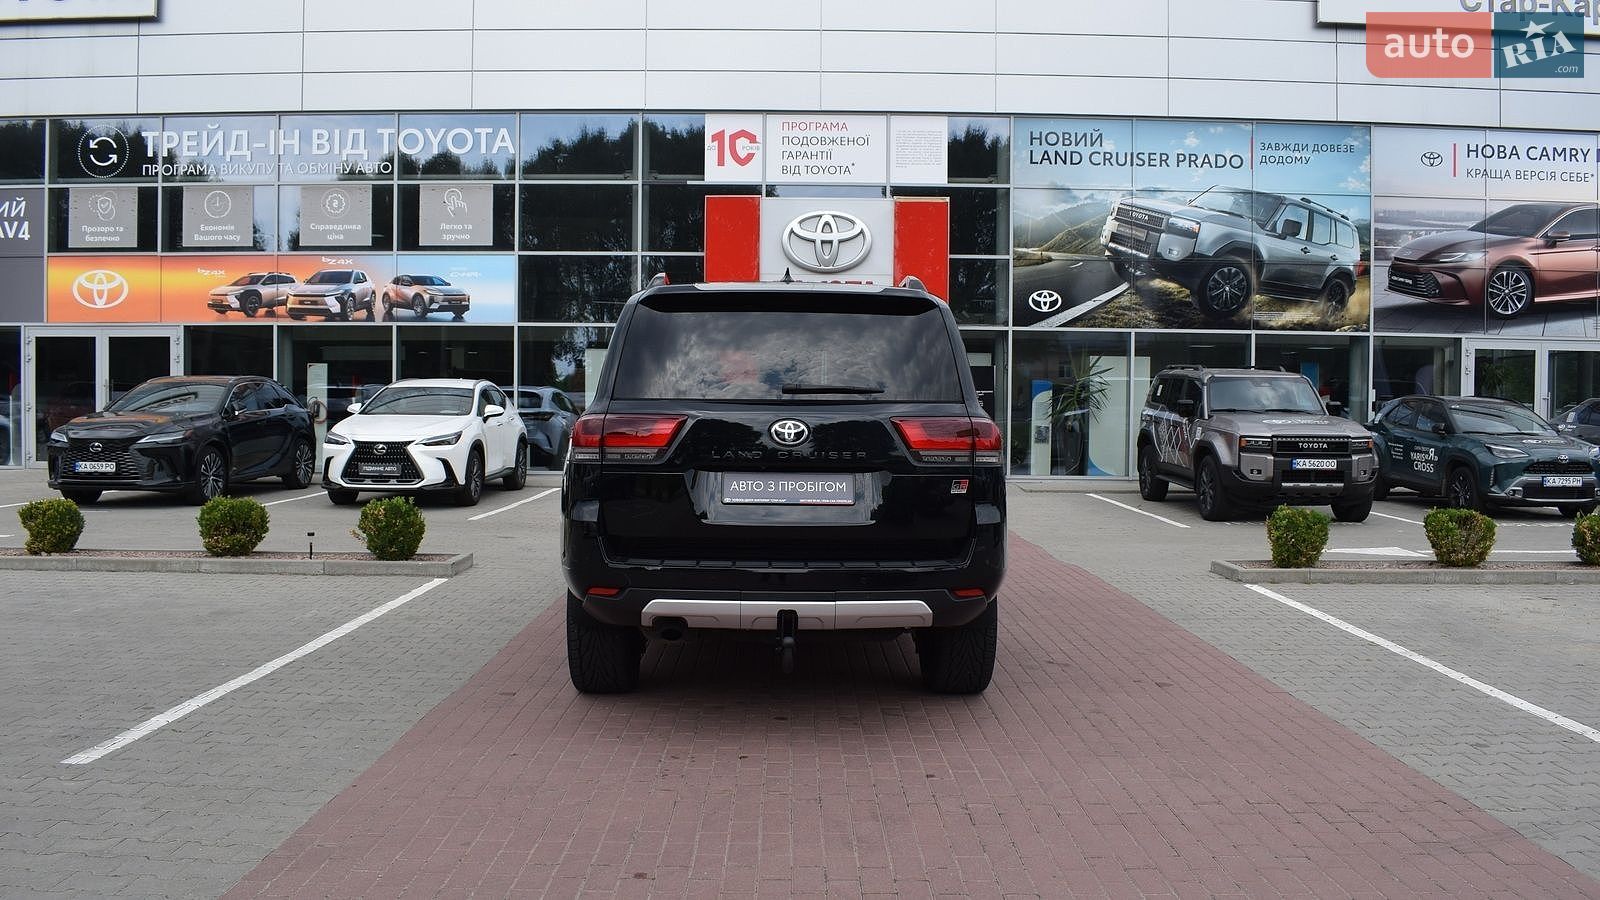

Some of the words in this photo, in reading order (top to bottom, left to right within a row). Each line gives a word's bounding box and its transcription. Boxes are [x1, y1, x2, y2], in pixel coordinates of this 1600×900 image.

[781, 121, 849, 132] ПРОГРАМА
[141, 124, 300, 161] ТРЕЙД-ІН
[312, 128, 368, 160] ВІД
[376, 127, 516, 155] TOYOTA
[781, 134, 871, 147] ПОДОВЖЕНОЇ
[1029, 128, 1103, 148] НОВИЙ
[1260, 142, 1309, 153] ЗАВЖДИ
[1311, 143, 1355, 153] ДОВЕЗЕ
[1466, 143, 1521, 160] НОВА
[1526, 145, 1591, 163] CAMRY
[781, 149, 833, 160] ГАРАНТІЇ
[1029, 149, 1083, 165] LAND
[1088, 151, 1171, 167] CRUISER
[1176, 153, 1244, 169] PRADO
[1259, 155, 1311, 165] ДОДОМУ
[142, 163, 217, 176] ПРОГРАМА
[220, 163, 274, 176] ВИКУПУ
[278, 163, 294, 175] ТА
[297, 162, 352, 175] ОБМІНУ
[355, 162, 392, 174] АВТО
[781, 165, 801, 176] ВІД
[1466, 168, 1512, 181] КРАЩА
[1515, 169, 1557, 182] ВЕРСІЯ
[81, 225, 114, 234] Прозоро
[310, 223, 362, 231] Справедлива
[85, 234, 120, 242] безпечно
[194, 233, 222, 241] Вашого
[223, 234, 241, 242] часу
[327, 232, 344, 241] ціна
[442, 234, 471, 242] зручно
[711, 450, 763, 459] LAND
[777, 451, 867, 459] CRUISER
[1296, 460, 1307, 468] KA
[1413, 461, 1434, 473] CROSS
[730, 480, 764, 492] АВТО
[767, 481, 775, 492] З
[779, 481, 847, 492] ПРОБІГОМ
